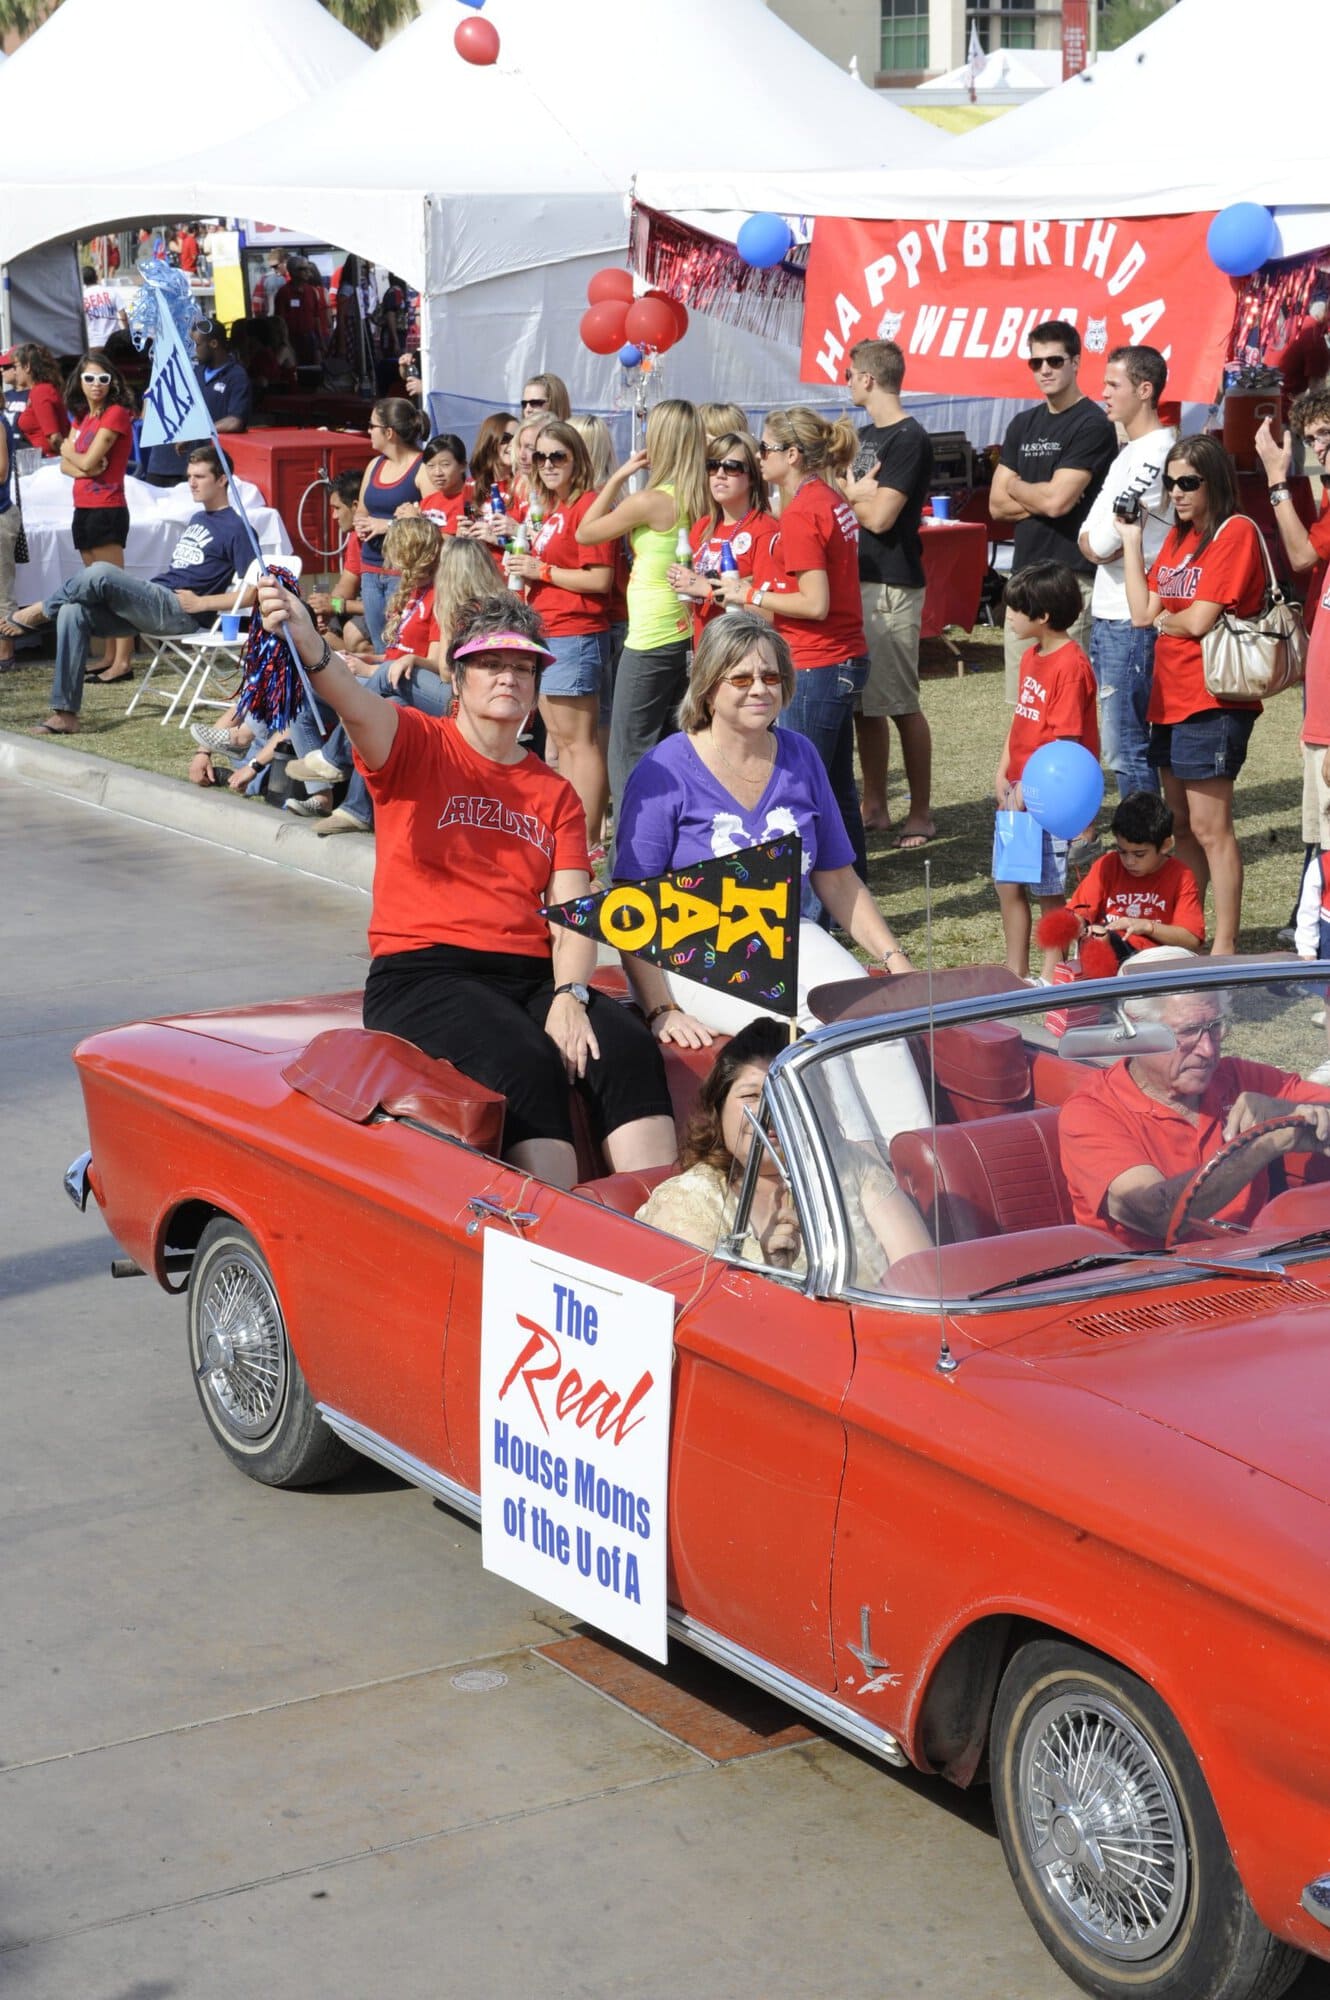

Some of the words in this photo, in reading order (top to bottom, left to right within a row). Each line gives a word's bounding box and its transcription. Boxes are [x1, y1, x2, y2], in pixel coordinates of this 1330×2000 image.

[909, 304, 1079, 359] WiLBU
[1106, 892, 1166, 912] ARIZONA
[553, 1283, 598, 1346] The
[498, 1313, 655, 1447] Real
[494, 1419, 568, 1498] House
[574, 1458, 650, 1539] Moms
[503, 1497, 527, 1542] of
[531, 1506, 570, 1565] the
[576, 1526, 592, 1577] U
[597, 1545, 621, 1593] of
[624, 1552, 641, 1605] A
